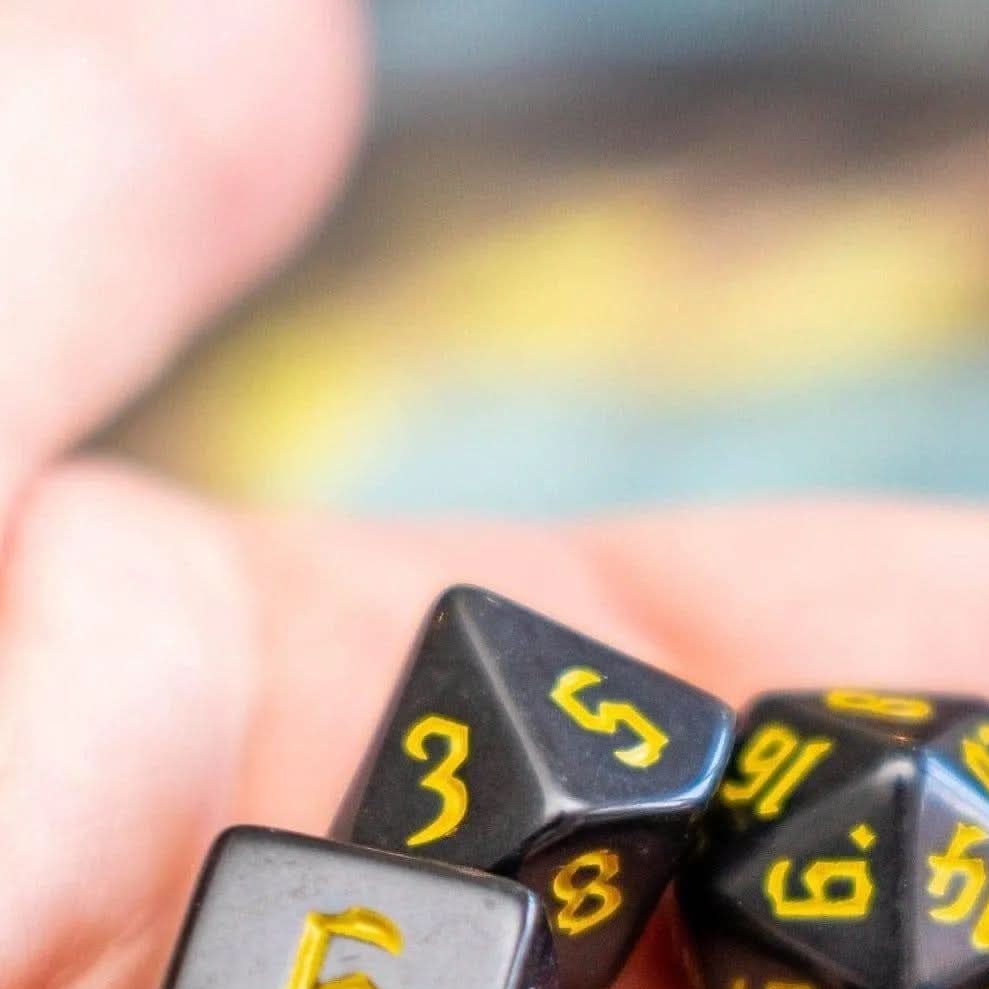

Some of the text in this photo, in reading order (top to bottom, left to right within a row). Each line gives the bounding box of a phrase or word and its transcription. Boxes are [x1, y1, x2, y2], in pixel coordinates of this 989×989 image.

[553, 667, 668, 766] 5
[403, 713, 472, 848] 3
[550, 847, 624, 938] 8
